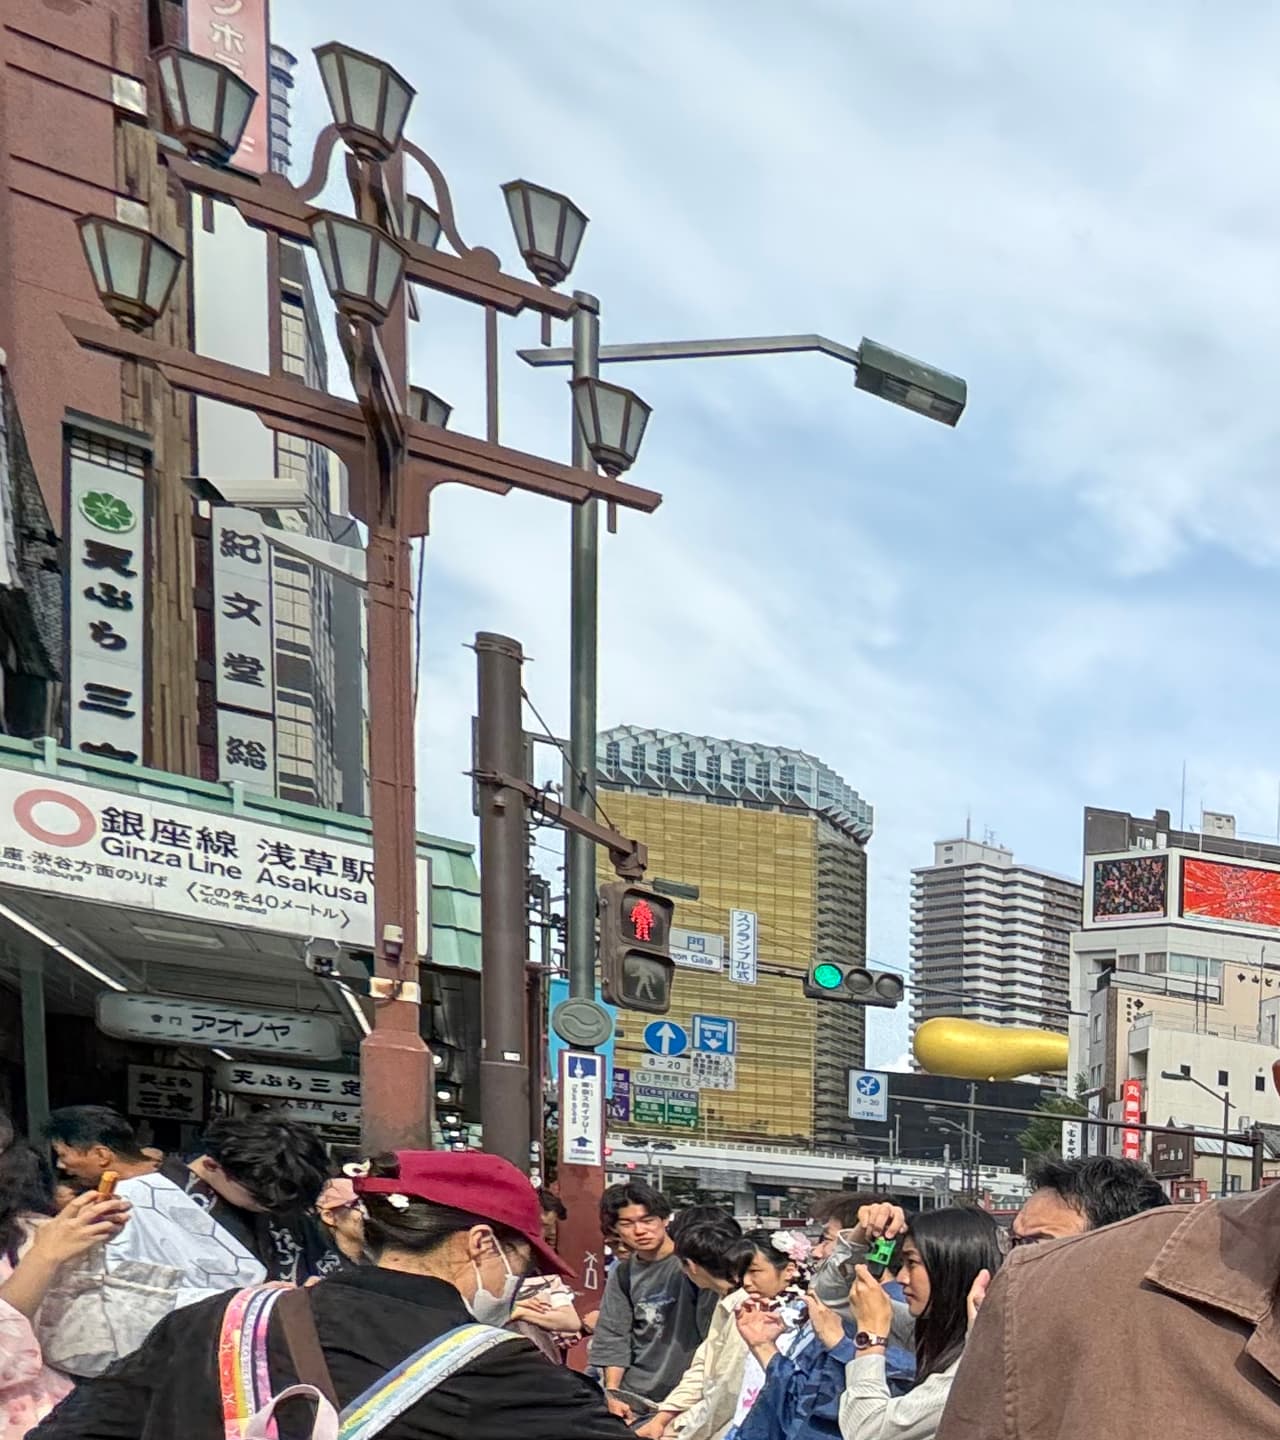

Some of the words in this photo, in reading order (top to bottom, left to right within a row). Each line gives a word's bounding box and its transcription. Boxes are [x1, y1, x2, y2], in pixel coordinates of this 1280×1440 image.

[101, 806, 239, 858] 銀座線
[256, 838, 375, 886] 浅草駅
[101, 836, 181, 868] Ginza
[188, 852, 242, 880] Line
[256, 868, 368, 905] Asakusa
